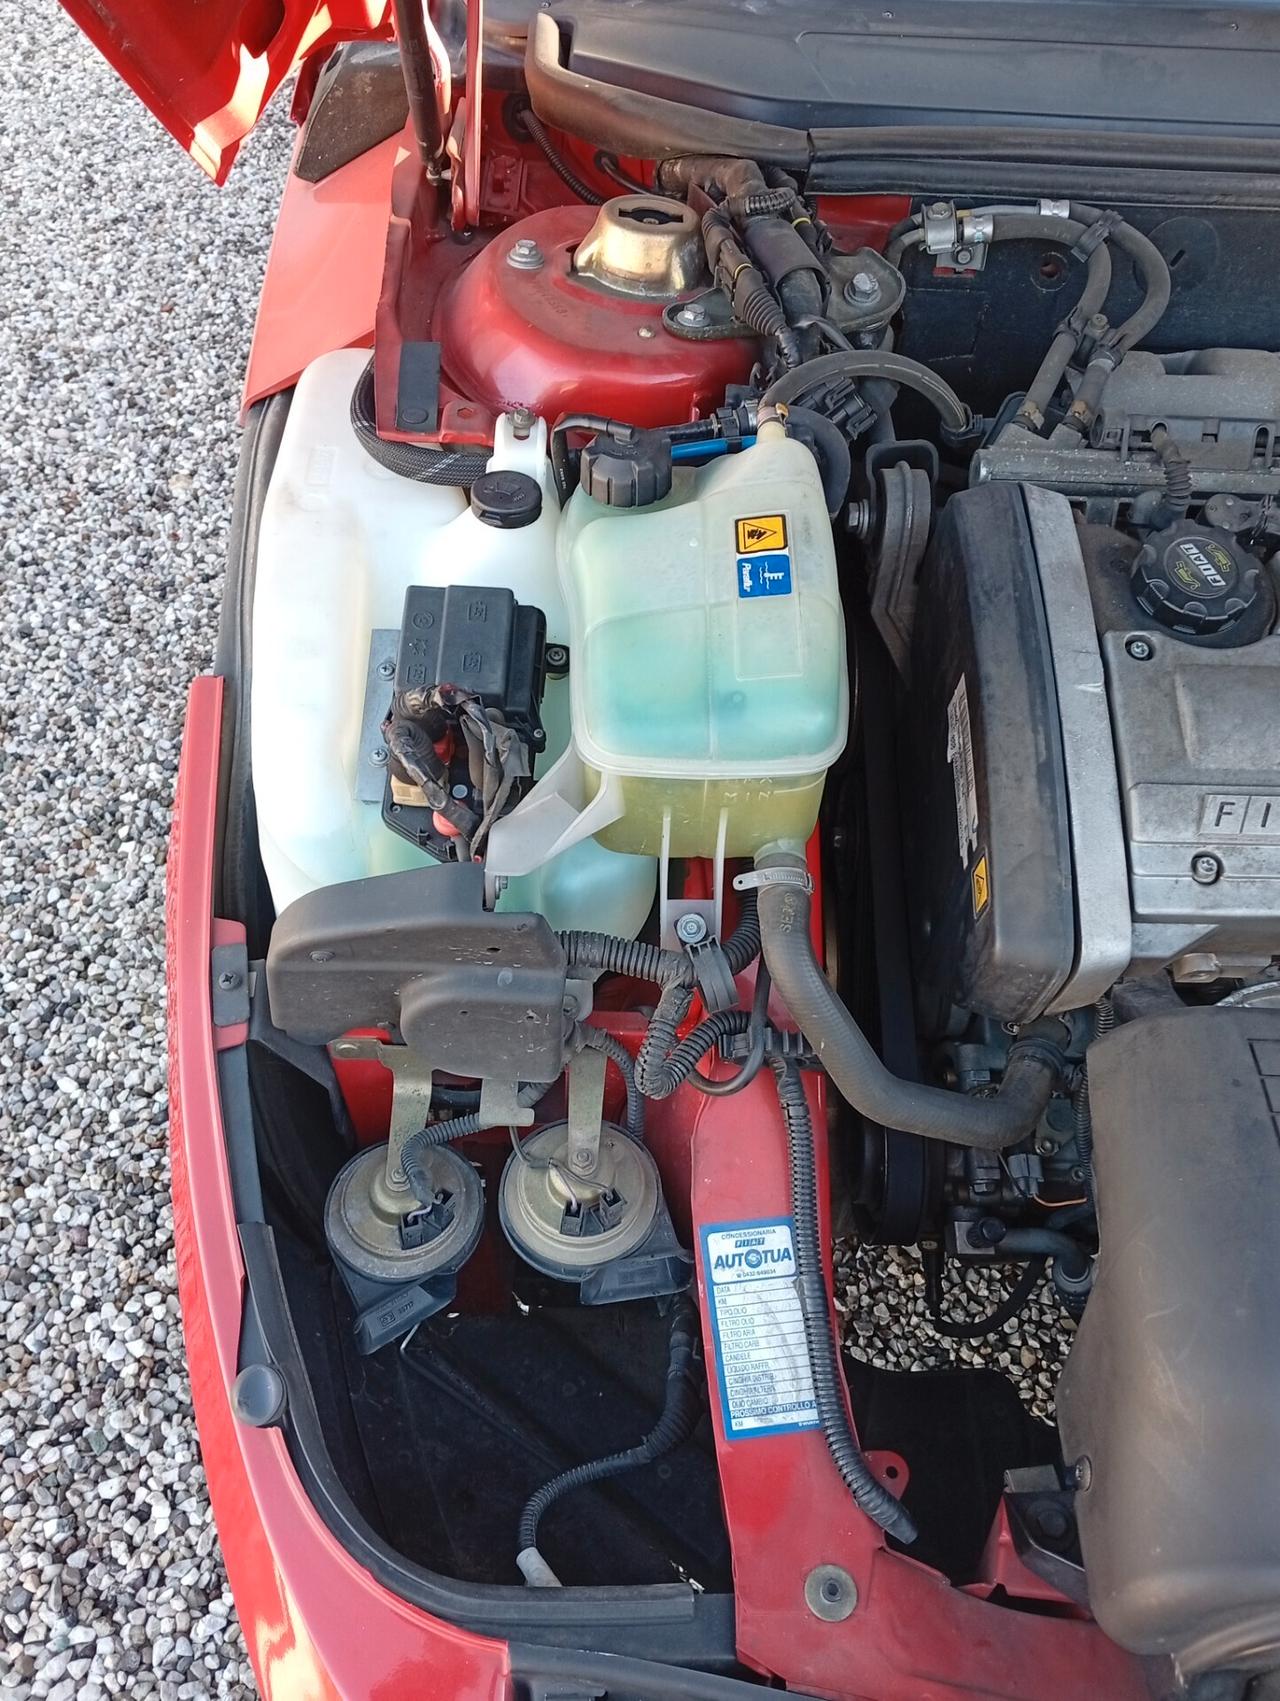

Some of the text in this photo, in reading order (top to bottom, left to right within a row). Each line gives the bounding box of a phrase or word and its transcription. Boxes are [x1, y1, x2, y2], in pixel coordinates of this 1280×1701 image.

[1180, 543, 1226, 586] FIAT
[721, 1229, 776, 1240] CONCESSIONARIA
[735, 1237, 765, 1248] FIAT
[716, 1286, 731, 1295] DATA
[720, 1306, 748, 1316] TIPO OLIO
[721, 1317, 755, 1328] FILTRO OLIO
[722, 1328, 756, 1340] FILTRO ARIA
[724, 1341, 743, 1351] FILTRO
[725, 1352, 751, 1362] CANDELE
[726, 1364, 750, 1374] LIQUIDO
[728, 1374, 751, 1385] CINGHIA
[731, 1397, 769, 1409] OLIO CAMBIO
[731, 1406, 767, 1418] PROSSIMO
[767, 1402, 811, 1414] CONTROLLO
